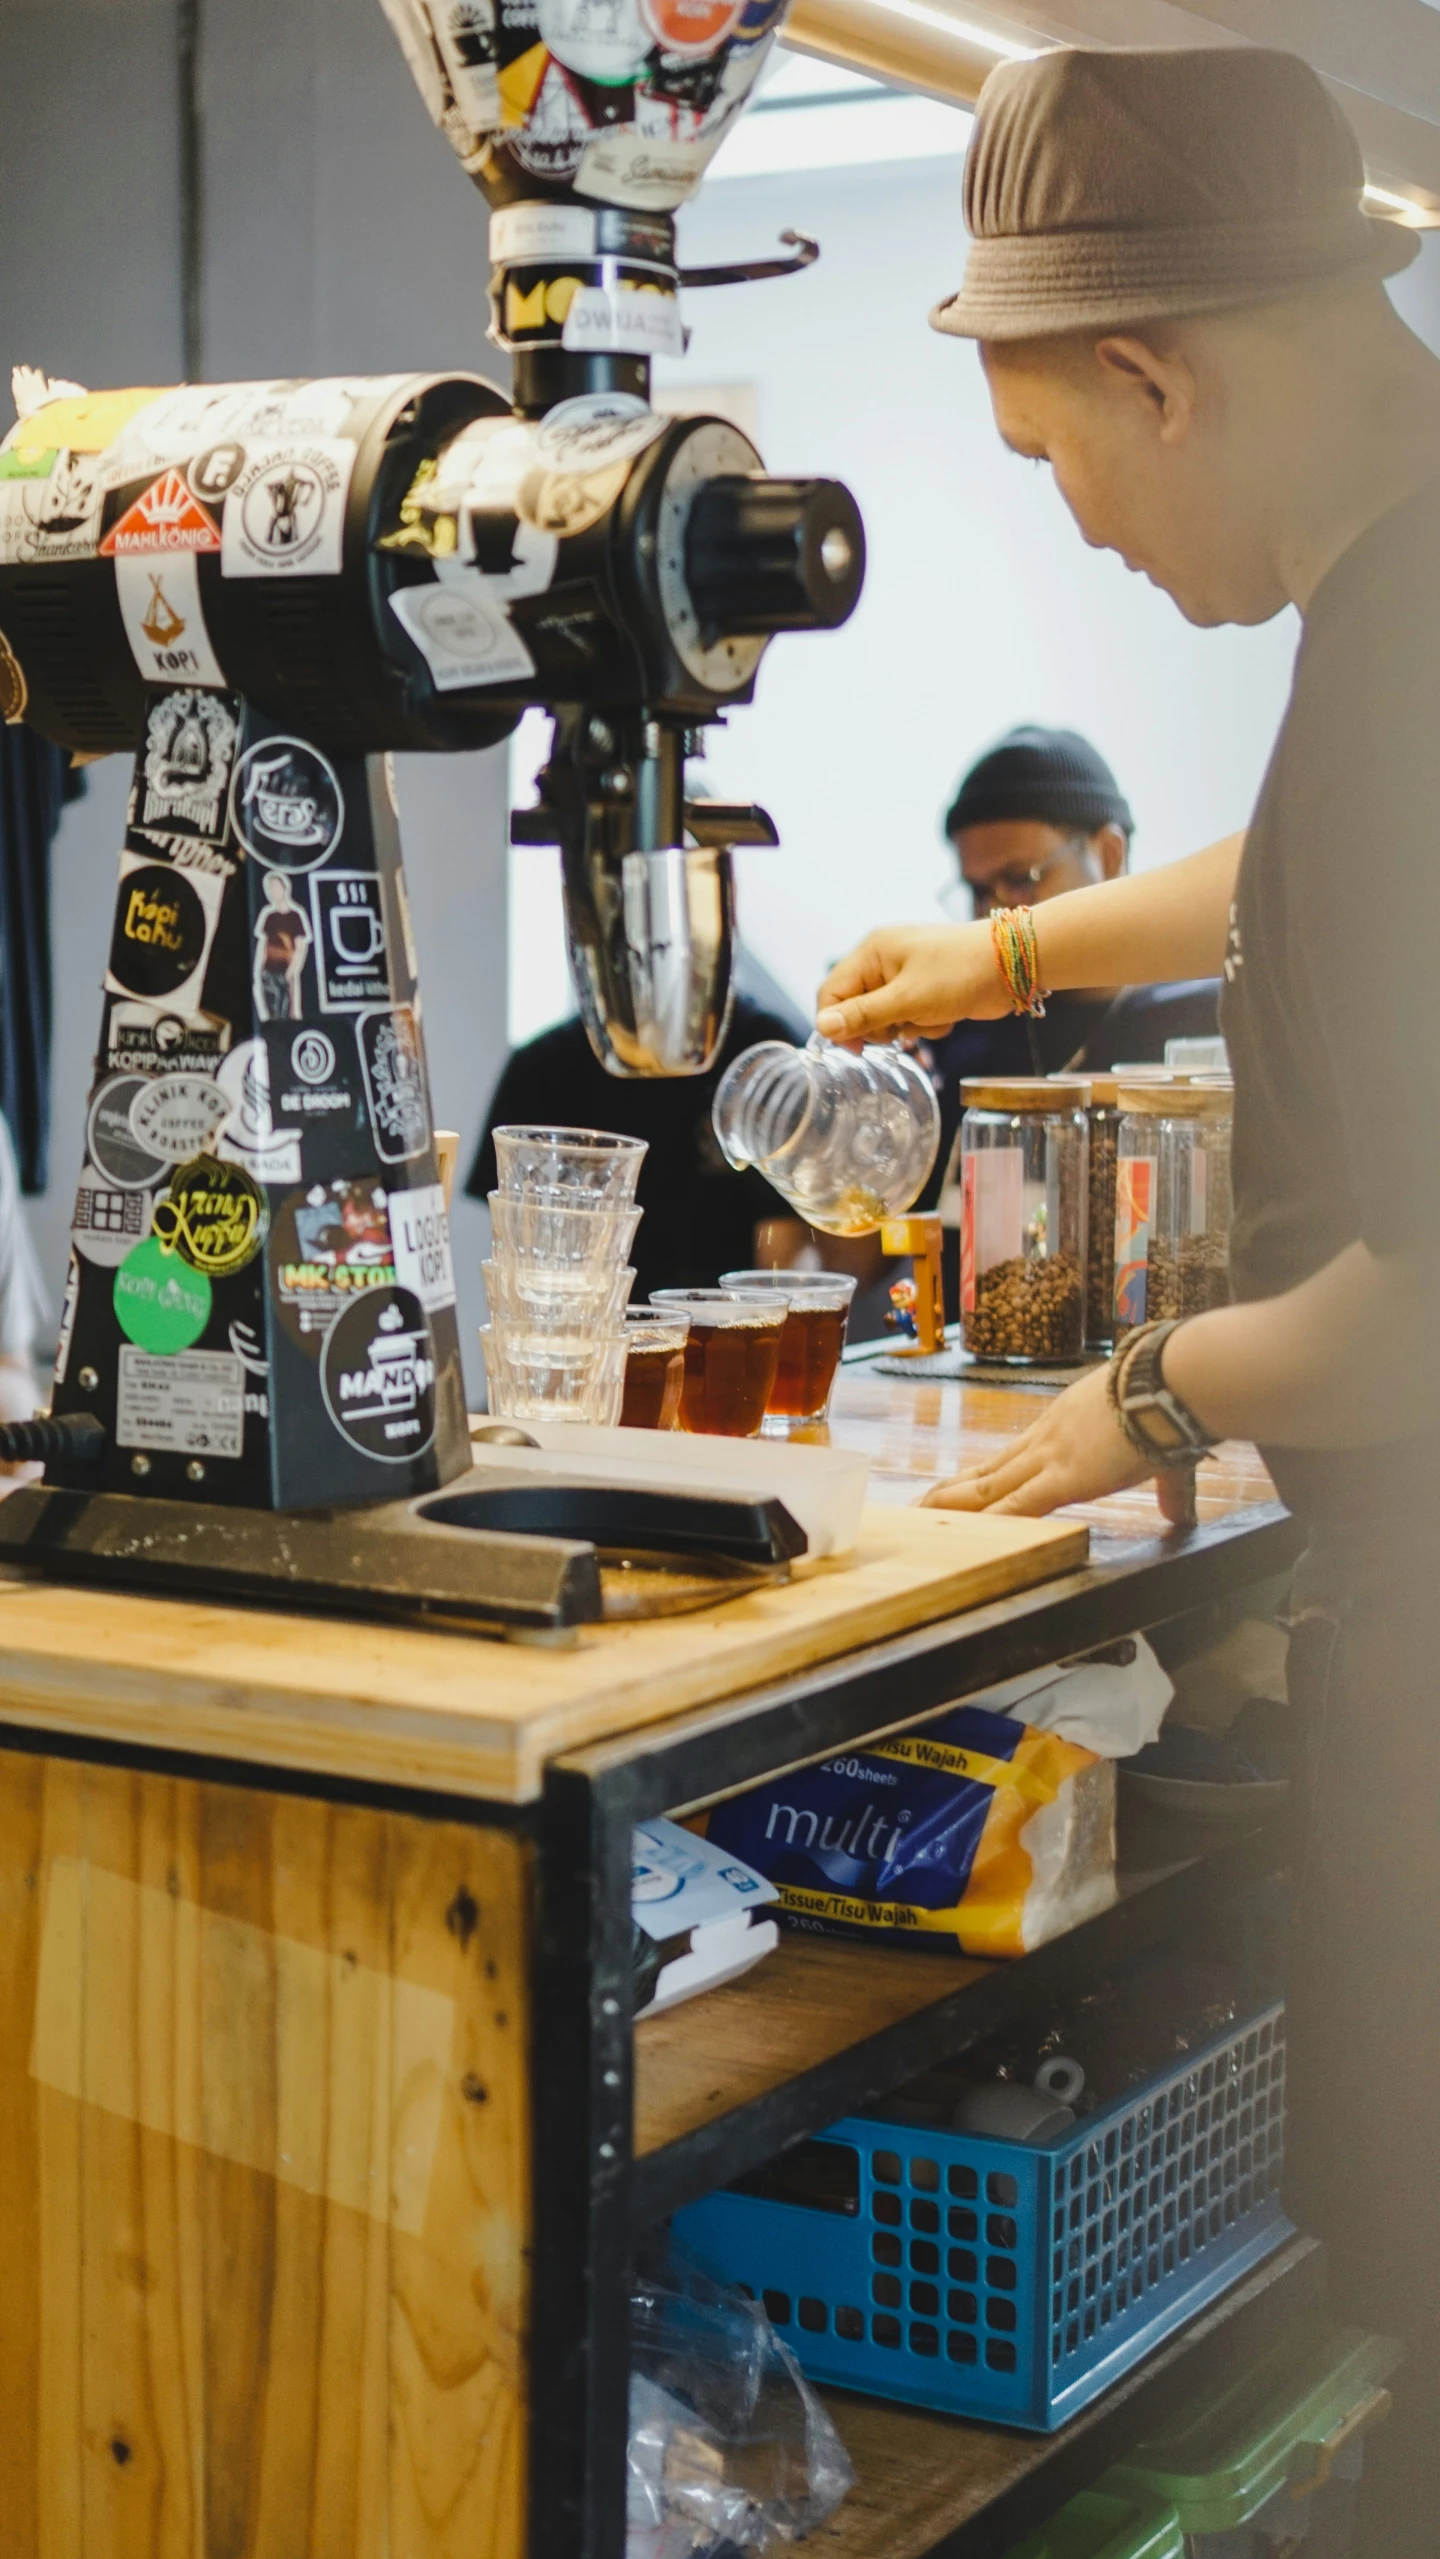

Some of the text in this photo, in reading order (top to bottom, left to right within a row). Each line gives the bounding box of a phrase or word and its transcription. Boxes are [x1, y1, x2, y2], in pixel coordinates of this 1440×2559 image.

[115, 526, 210, 550] MAHLKÖNIG
[152, 650, 199, 670] KOPI
[199, 1089, 227, 1121] KOP
[284, 1262, 331, 1291] MK
[916, 1742, 968, 1772] Wajah
[765, 1802, 912, 1864] multi
[868, 1903, 917, 1926] Wajah
